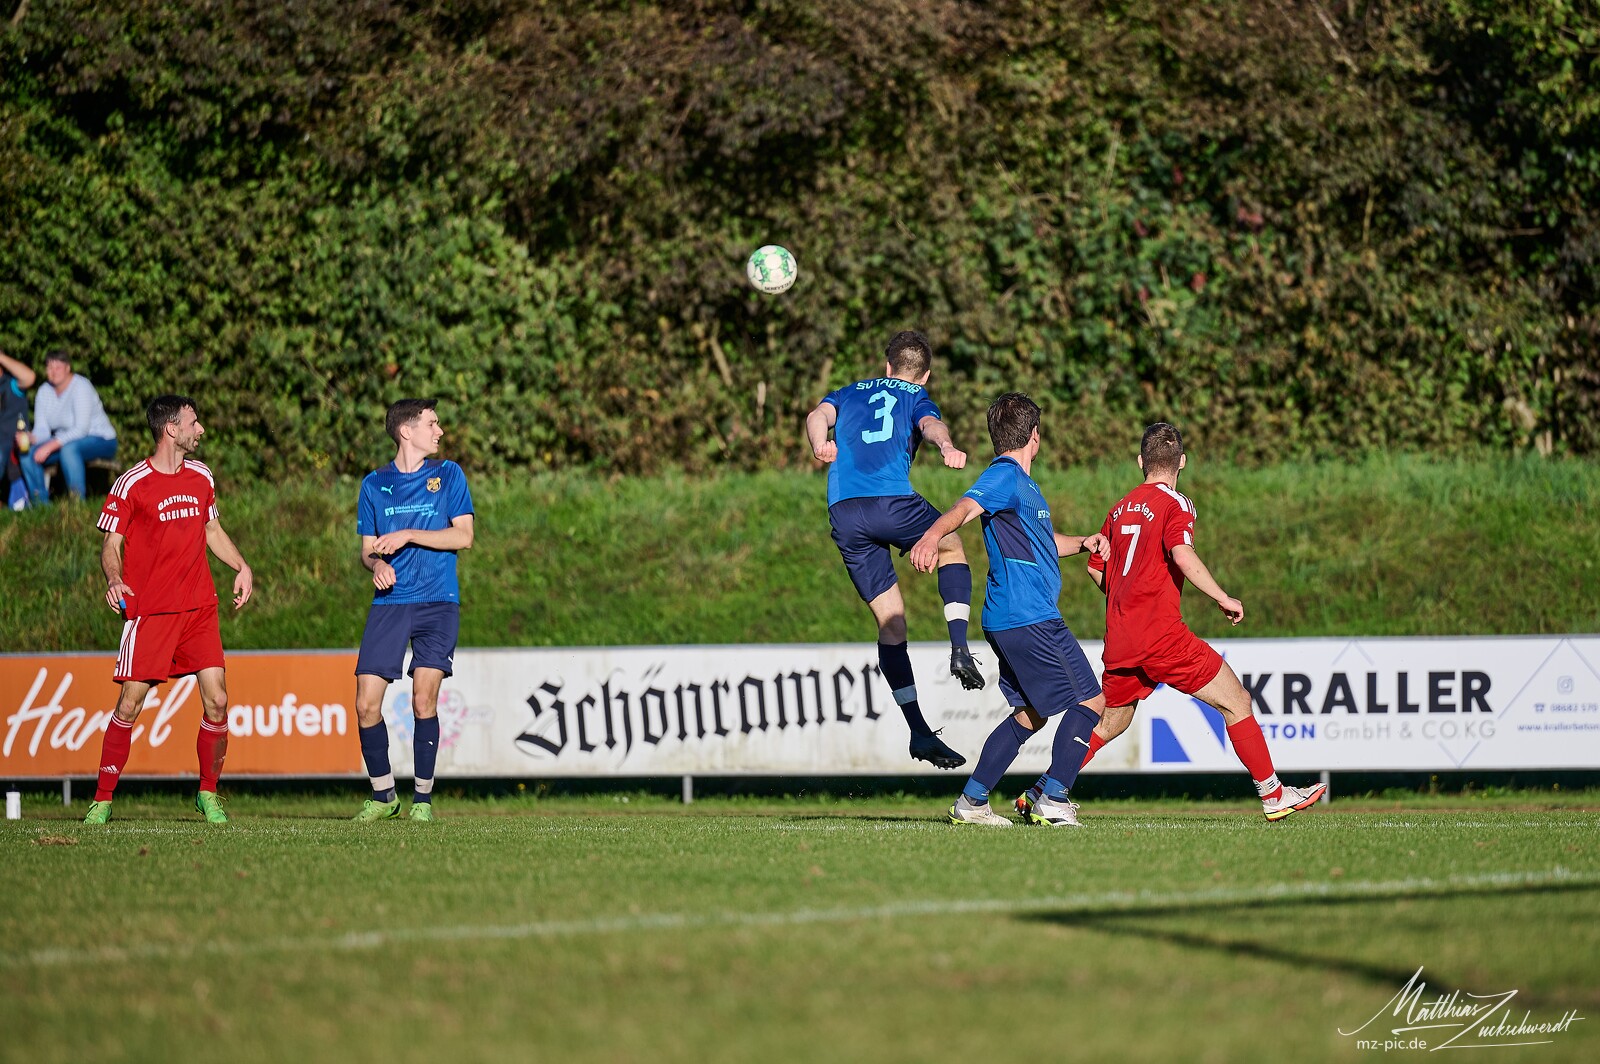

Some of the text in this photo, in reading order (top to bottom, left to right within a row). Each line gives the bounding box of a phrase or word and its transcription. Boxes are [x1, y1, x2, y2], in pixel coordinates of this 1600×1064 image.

[855, 380, 874, 391] SV
[861, 389, 898, 445] 3
[157, 494, 199, 511] GASTHAUS
[158, 506, 201, 522] GREIMEL
[1112, 503, 1125, 522] SV
[1120, 524, 1142, 577] 7
[1241, 671, 1493, 715] KRALLER
[228, 692, 348, 737] aufen
[515, 660, 882, 768] Schönramer
[1260, 723, 1316, 739] TON
[1323, 720, 1391, 741] GmbH
[1399, 721, 1413, 740] &
